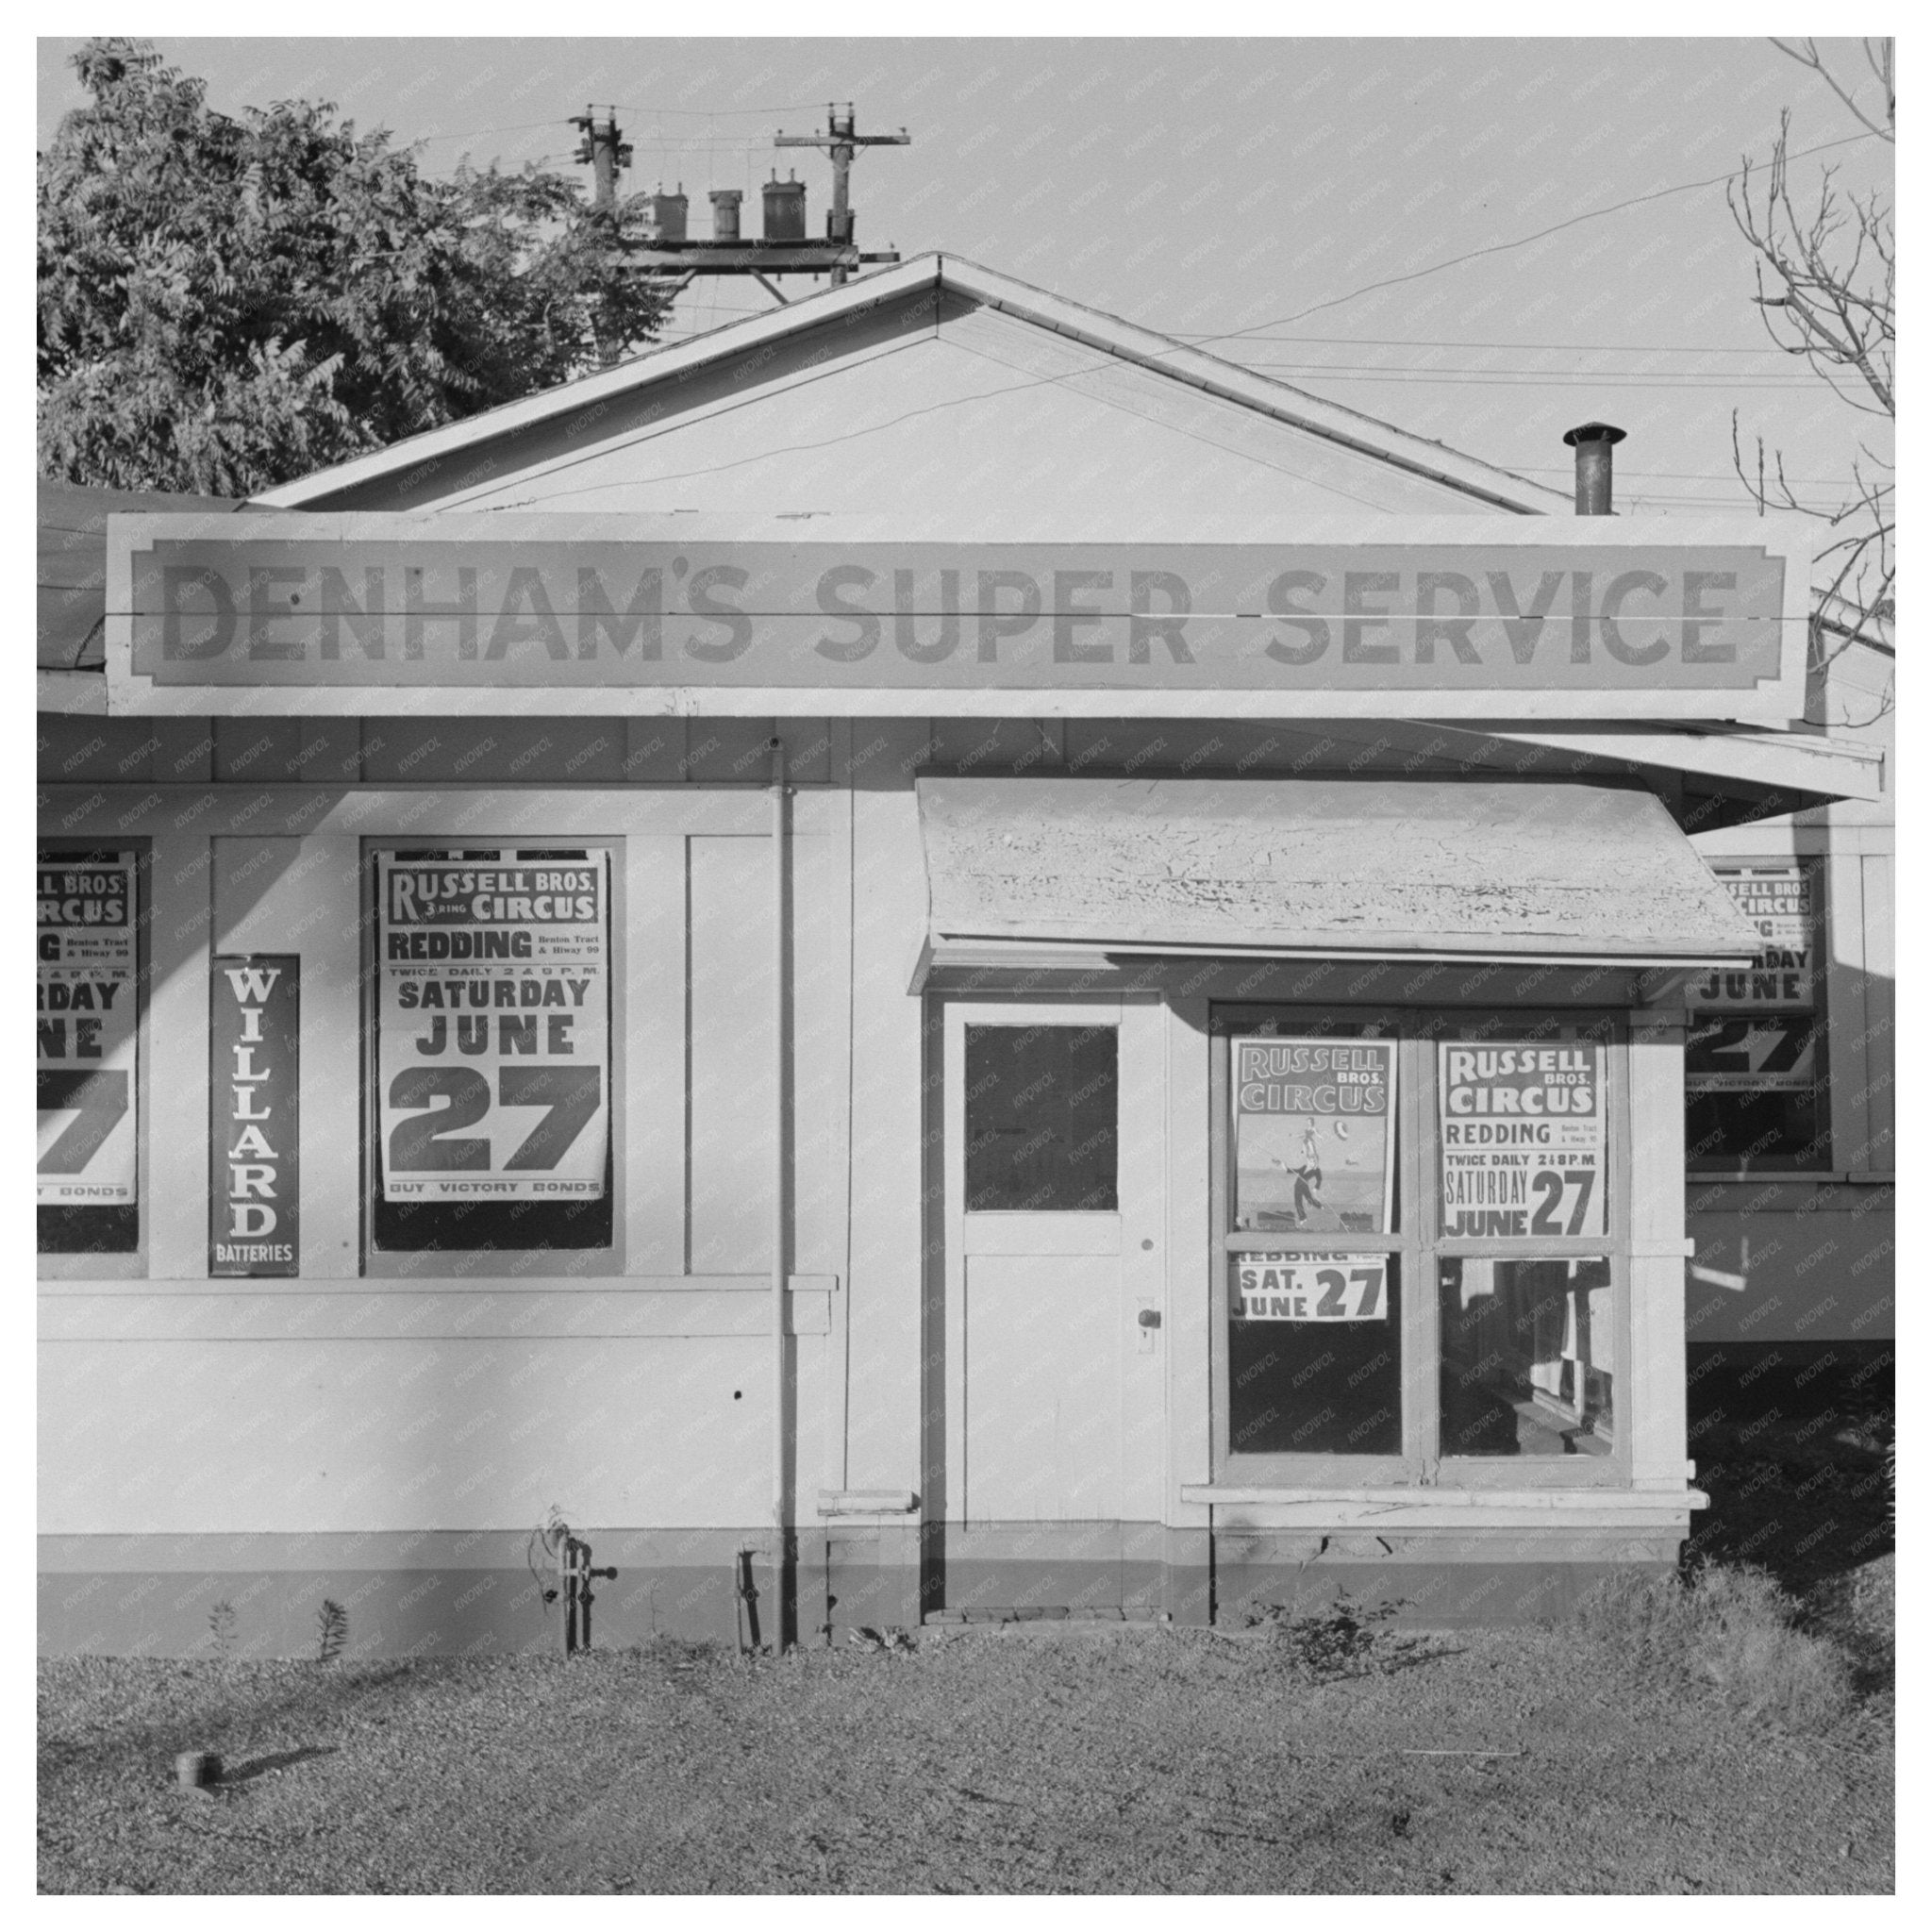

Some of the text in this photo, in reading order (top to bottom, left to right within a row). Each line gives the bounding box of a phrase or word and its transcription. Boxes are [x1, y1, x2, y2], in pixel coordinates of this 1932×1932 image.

[162, 555, 1739, 666] DENHAM'S SUPER SERVICE
[64, 874, 125, 895] BROS.
[392, 872, 595, 921] RUSSELL BROS.
[425, 902, 467, 916] 3 RING
[471, 894, 594, 920] CIRCUS
[388, 930, 533, 960] REDDING
[538, 935, 599, 944] Benton Tract
[538, 946, 600, 956] & Hiway 99
[389, 968, 439, 977] TWICE
[448, 967, 493, 976] DAILY
[503, 968, 514, 976] 2
[398, 978, 591, 1009] SATURDAY
[1699, 973, 1801, 1000] JUNE
[415, 1014, 575, 1057] JUNE
[1241, 1047, 1385, 1083] RUSSELL
[1337, 1072, 1383, 1085] BROS.
[1449, 1050, 1591, 1087] RUSSELL
[1543, 1074, 1591, 1085] BROS.
[224, 968, 282, 1239] WILLARD
[1240, 1084, 1386, 1113] CIRCUS
[1448, 1086, 1593, 1114] CIRCUS
[388, 1064, 601, 1173] 27
[1445, 1124, 1551, 1144] REDDING
[1445, 1154, 1487, 1166] TWICE
[1491, 1154, 1531, 1166] DAILY
[59, 1187, 128, 1196] BONDS
[389, 1182, 601, 1193] BUY VICTORY BONDS
[1445, 1170, 1528, 1206] SATURDAY
[1530, 1170, 1596, 1237] 27
[1445, 1209, 1529, 1238] JUNE
[215, 1242, 293, 1263] BATTERIES
[1241, 1269, 1303, 1291] SAT.
[1315, 1268, 1384, 1318] 27
[1232, 1296, 1307, 1318] JUNE
